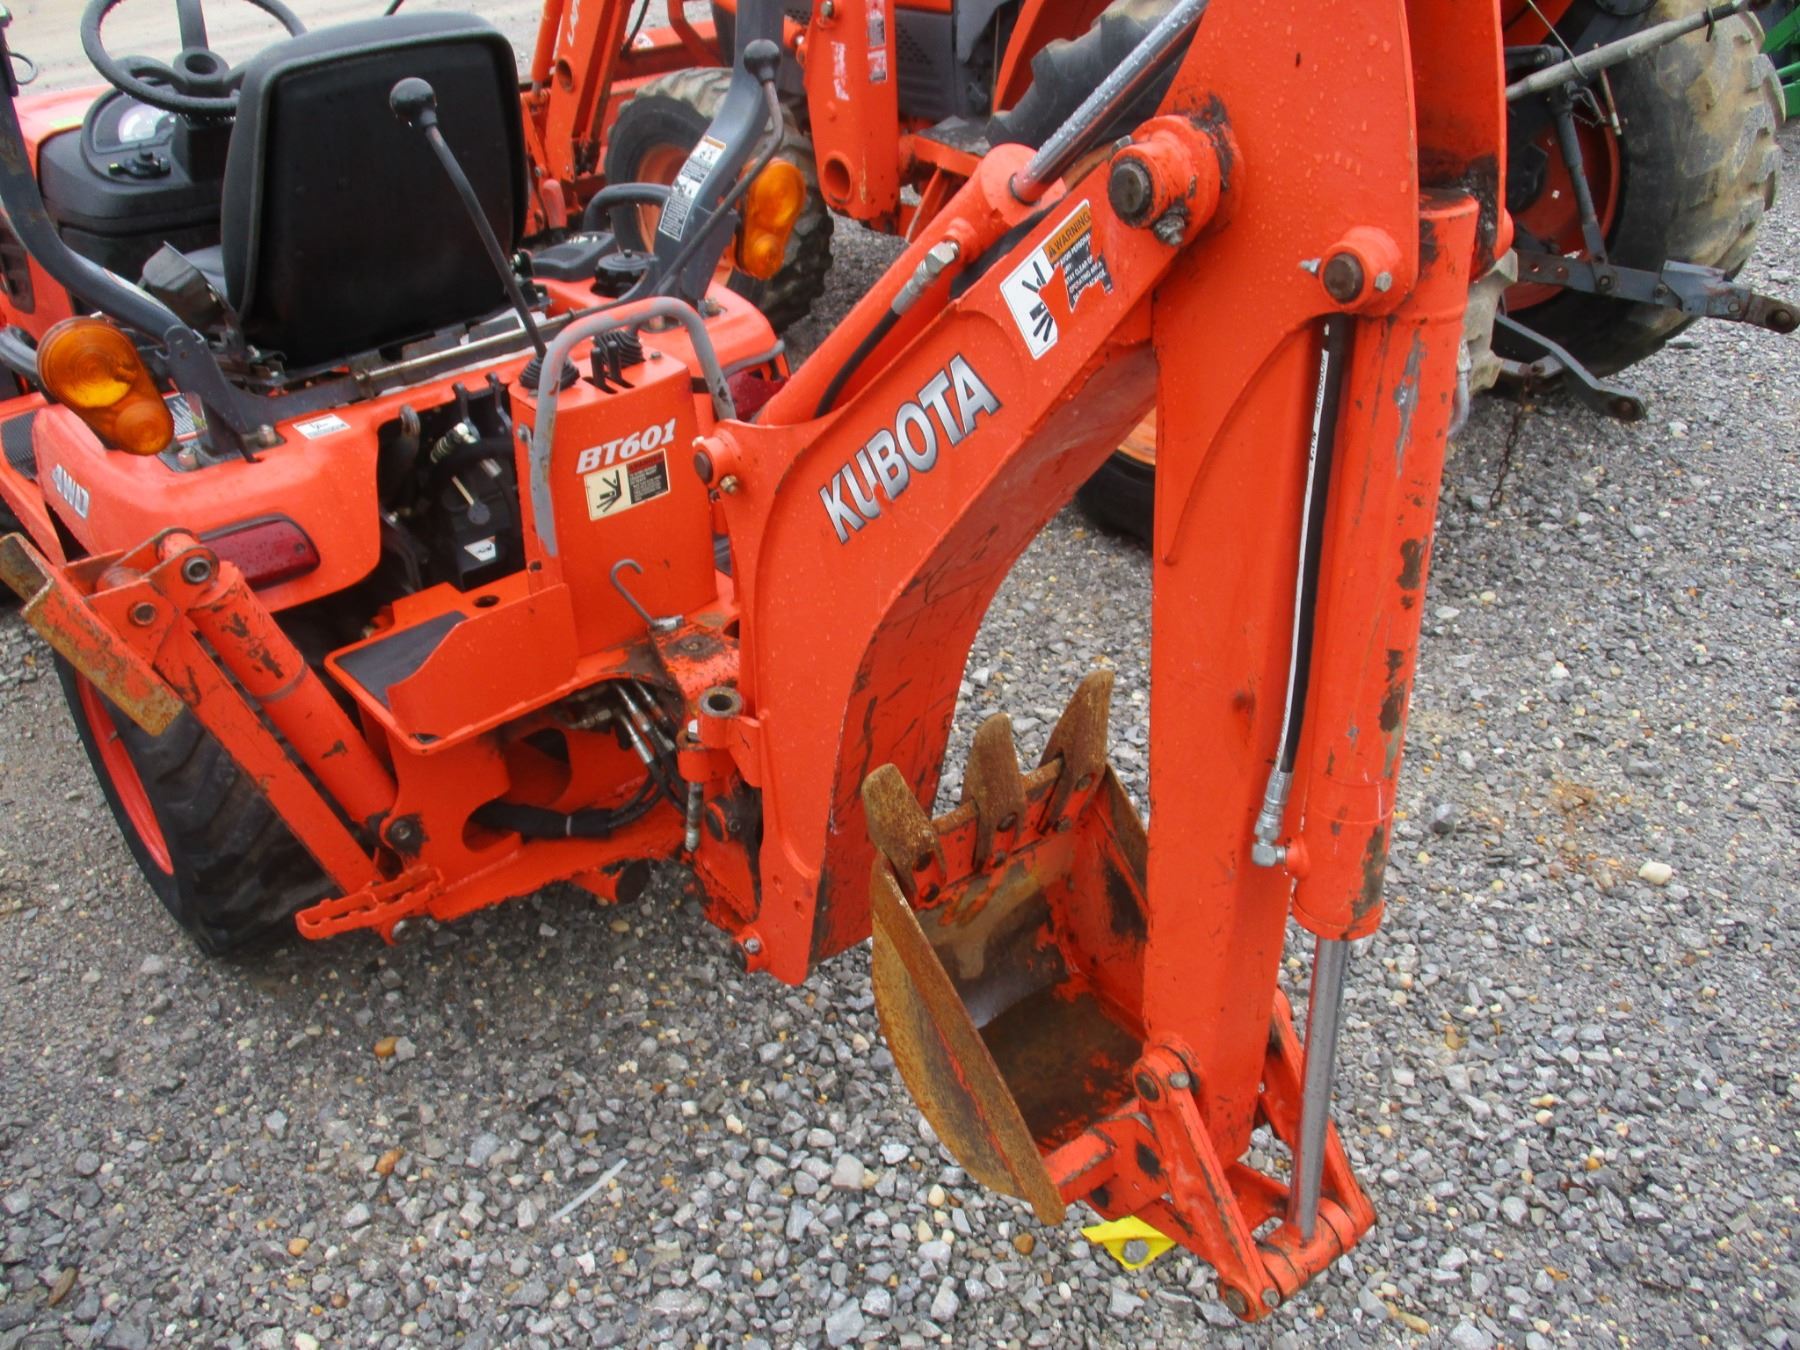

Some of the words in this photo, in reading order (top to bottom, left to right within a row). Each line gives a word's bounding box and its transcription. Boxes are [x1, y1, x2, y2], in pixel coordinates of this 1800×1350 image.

[1054, 211, 1091, 249] WARNING
[575, 417, 677, 475] BT601
[818, 351, 1003, 545] KUBOTA
[52, 463, 89, 519] 4WD
